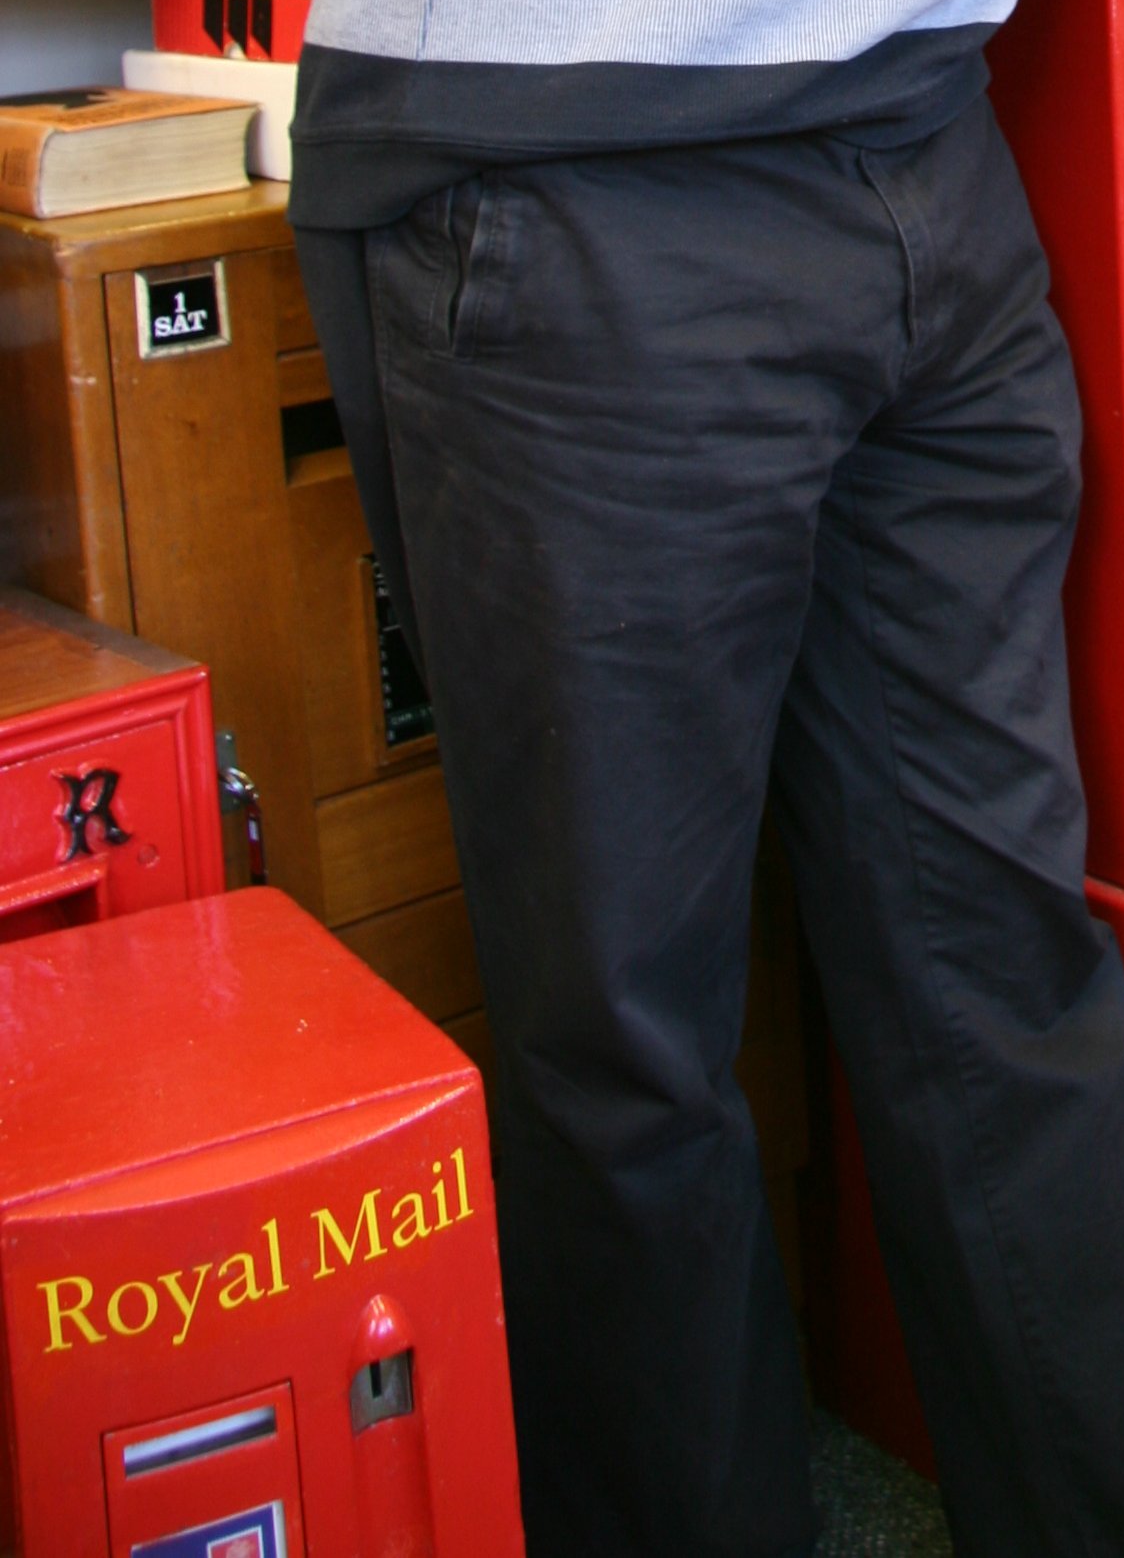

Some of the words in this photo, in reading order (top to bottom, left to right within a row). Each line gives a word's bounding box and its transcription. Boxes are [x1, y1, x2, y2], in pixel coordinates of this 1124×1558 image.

[174, 291, 188, 313] 1
[153, 308, 209, 338] SAT
[36, 1217, 290, 1354] Royal
[310, 1146, 475, 1280] Mail
